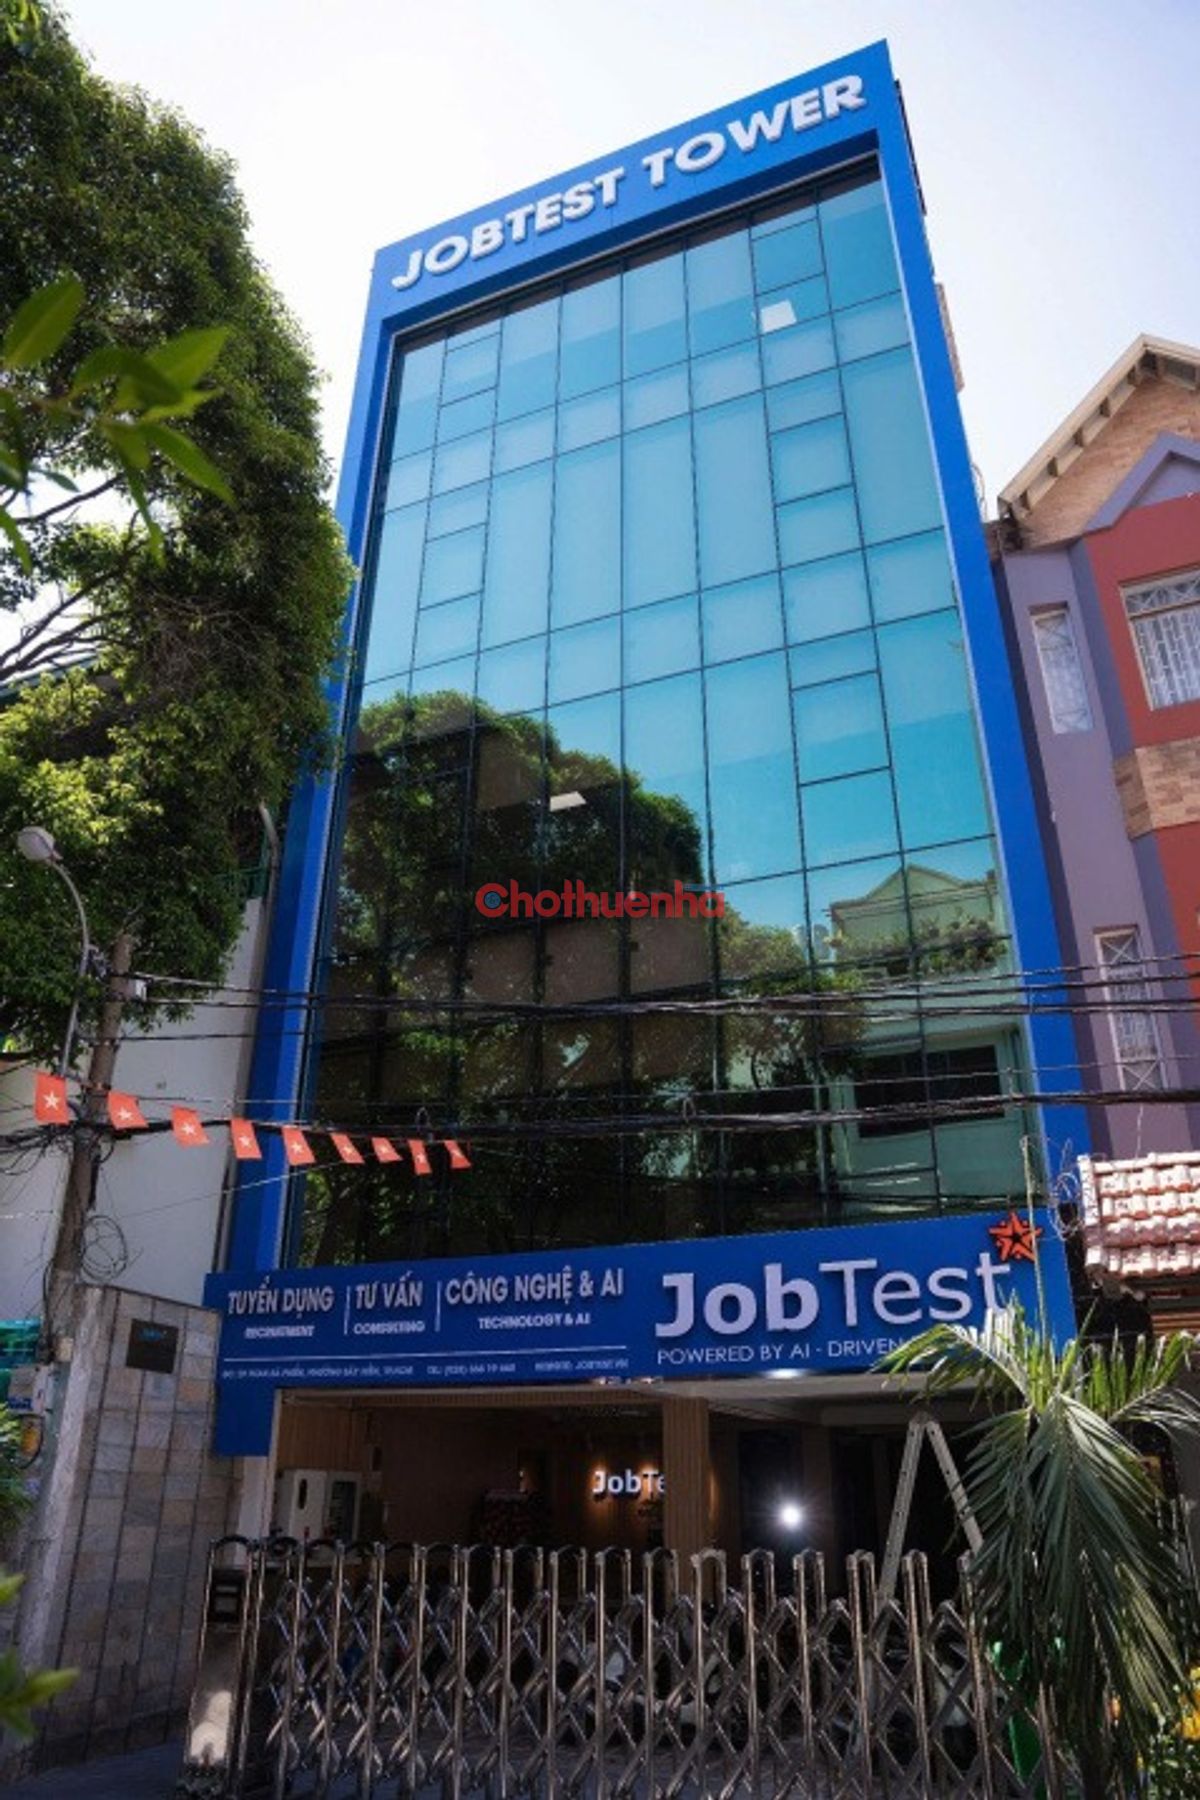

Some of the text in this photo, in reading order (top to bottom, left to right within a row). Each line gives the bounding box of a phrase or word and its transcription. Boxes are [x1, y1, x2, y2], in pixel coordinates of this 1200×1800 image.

[391, 74, 867, 290] JOBTEST TOWER
[228, 1275, 335, 1319] TUYỂN DỤNG
[355, 1270, 423, 1309] TƯ VẤN
[445, 1265, 624, 1305] CÔNG NGHỆ & AI
[655, 1252, 1011, 1337] JobTest
[478, 1314, 563, 1330] TECHNOLOGY
[657, 1343, 753, 1365] POWERED
[760, 1343, 783, 1361] BY
[788, 1341, 811, 1360] AI
